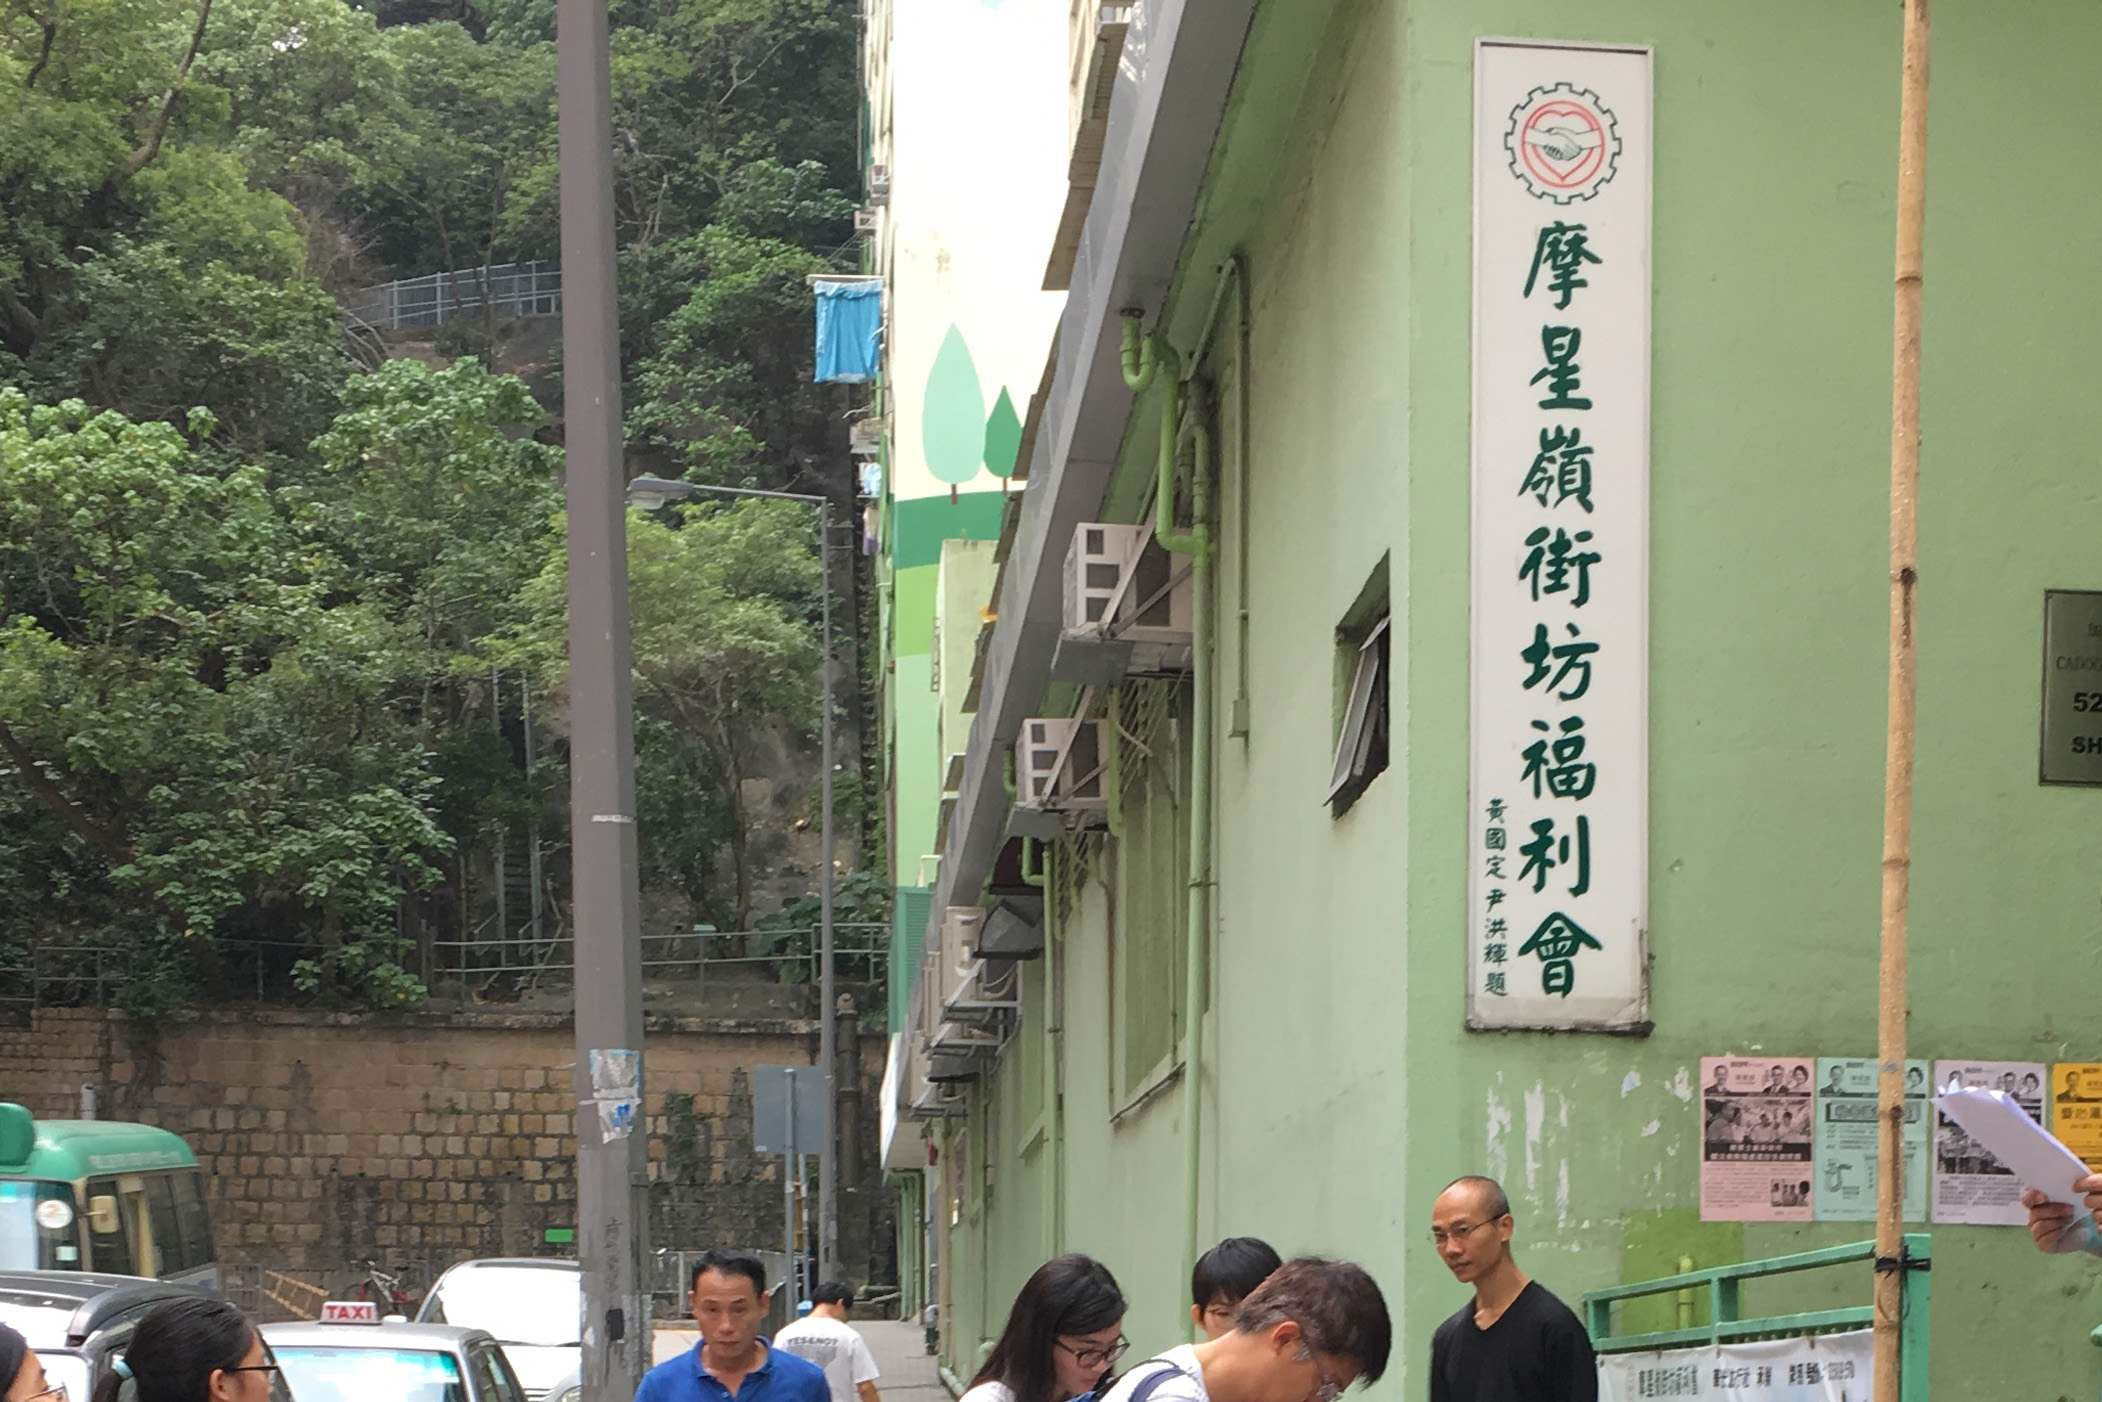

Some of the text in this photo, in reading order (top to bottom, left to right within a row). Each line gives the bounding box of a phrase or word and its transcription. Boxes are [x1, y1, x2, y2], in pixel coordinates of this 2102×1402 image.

[1517, 220, 1603, 999] 摩星嶺街坊福利會
[2072, 691, 2102, 713] 52
[325, 1305, 374, 1320] TAXI
